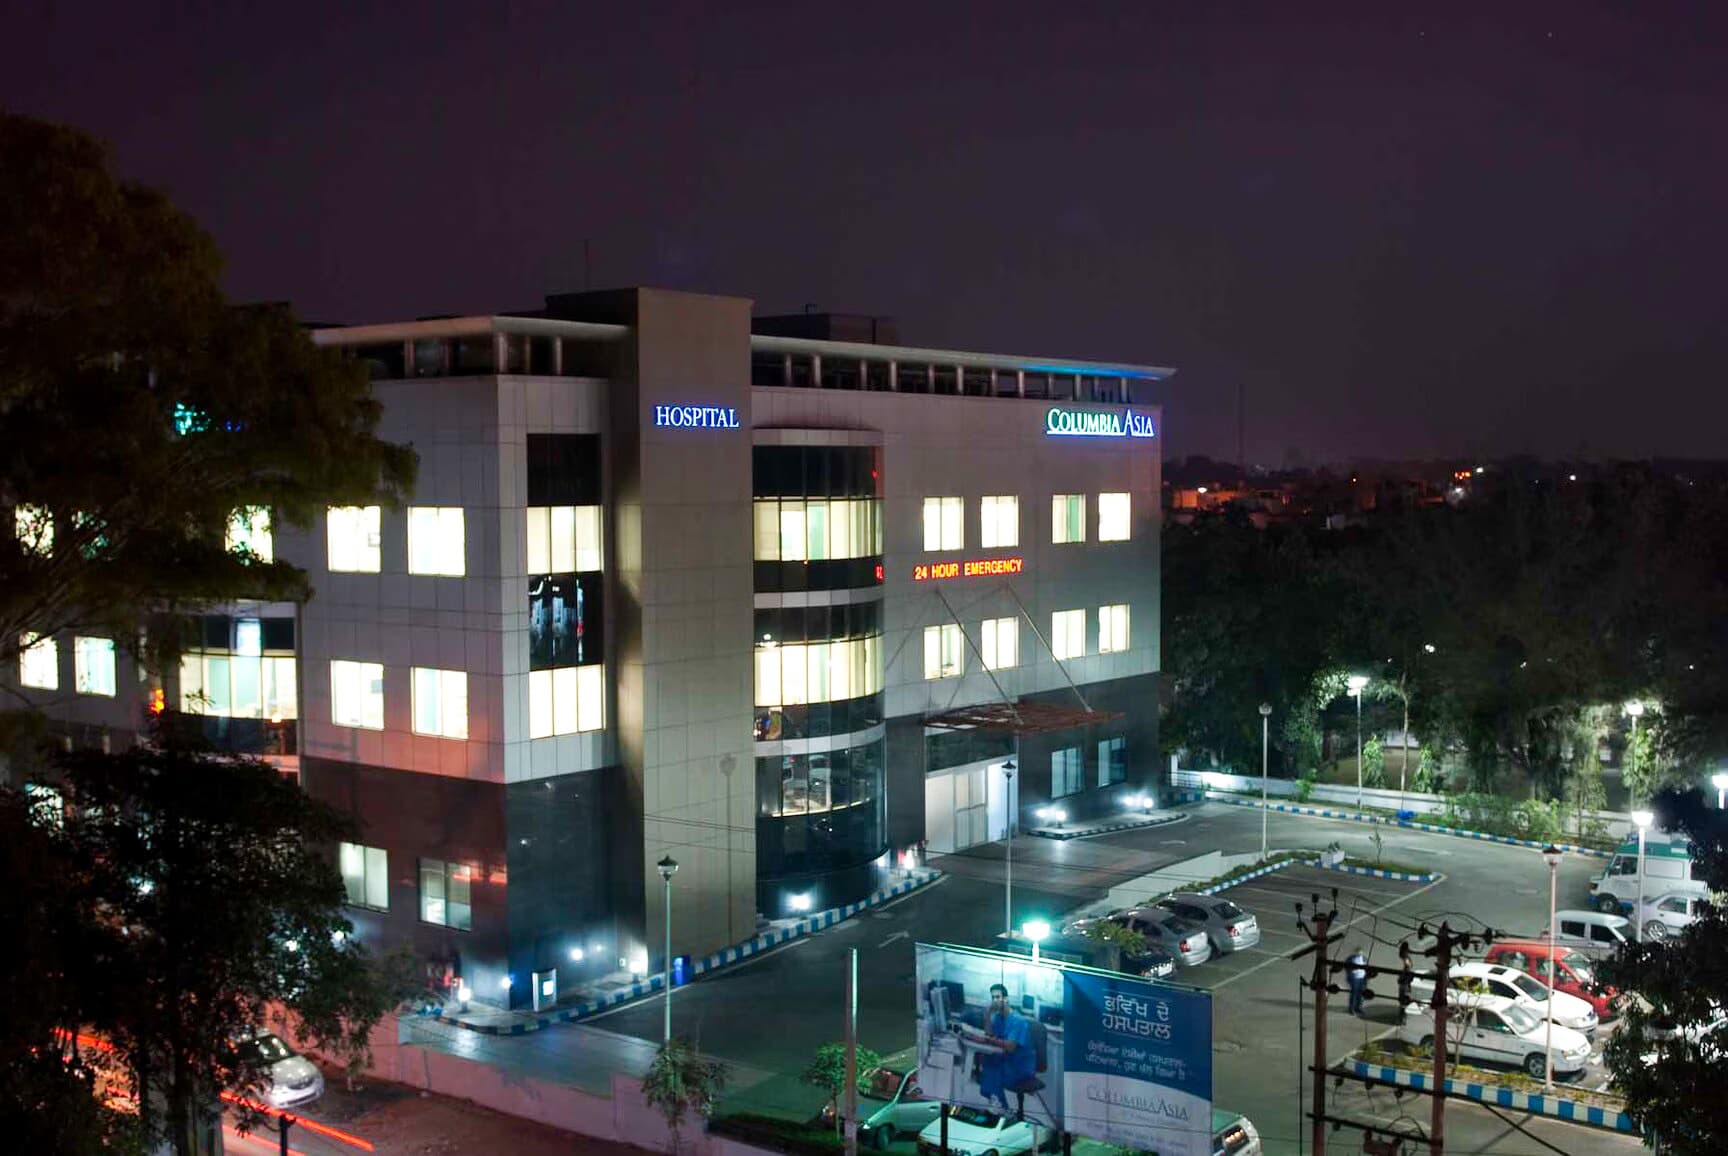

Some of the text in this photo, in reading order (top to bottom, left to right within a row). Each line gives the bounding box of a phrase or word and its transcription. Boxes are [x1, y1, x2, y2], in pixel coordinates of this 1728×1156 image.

[656, 406, 739, 427] HOSPITAL
[1047, 408, 1154, 436] COLUMBIA ASIA
[914, 559, 1023, 580] 24 HOUR EMERGENCY
